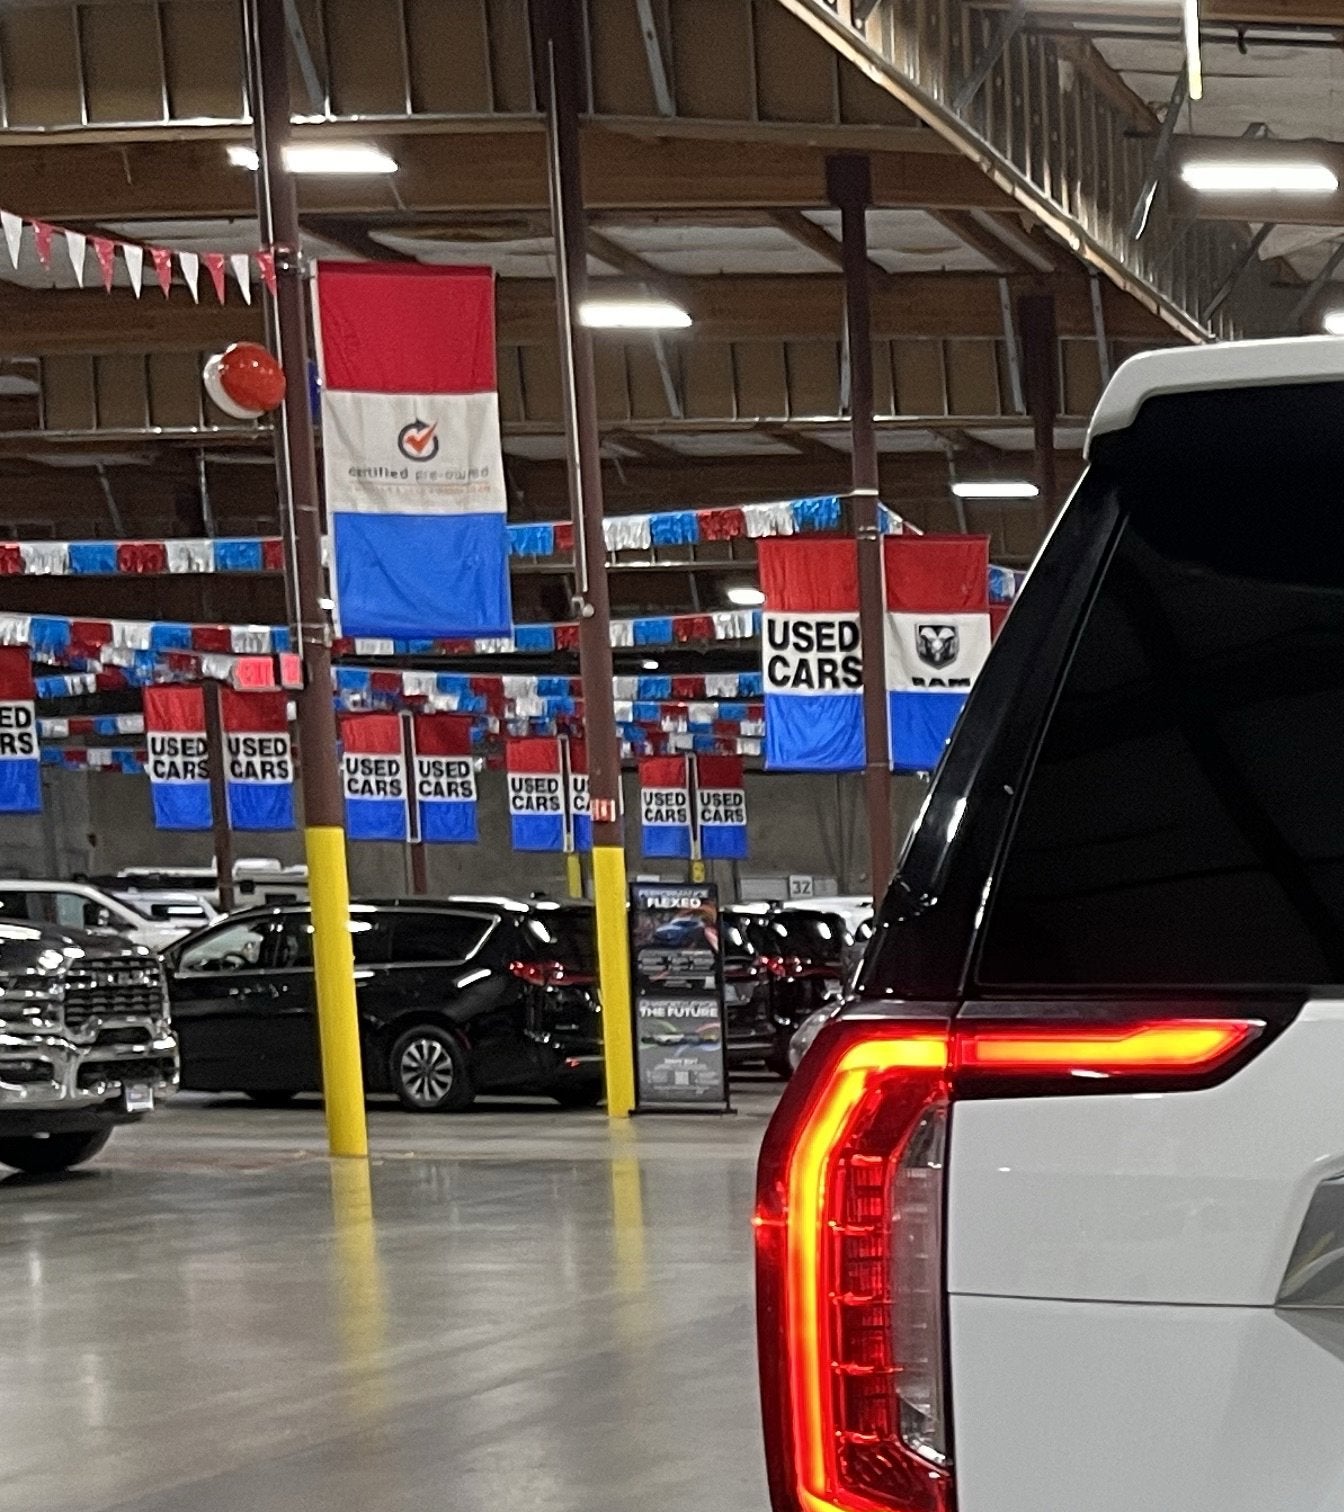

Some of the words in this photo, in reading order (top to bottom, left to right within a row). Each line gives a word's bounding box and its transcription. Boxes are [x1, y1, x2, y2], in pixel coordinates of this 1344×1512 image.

[767, 618, 860, 653] USED
[767, 655, 864, 689] CARS
[0, 706, 32, 728] ED
[0, 732, 34, 755] RS
[151, 737, 208, 758] USED
[227, 737, 288, 758] USED
[153, 760, 210, 780] CARS
[230, 760, 289, 780] CARS
[346, 758, 400, 777] USED
[418, 760, 470, 778] USED
[347, 778, 402, 796] CARS
[419, 780, 473, 798] CARS
[511, 778, 559, 794] USED
[511, 795, 561, 811] CARS
[643, 791, 686, 807] USED
[701, 792, 743, 807] USED
[644, 808, 687, 823] CARS
[701, 808, 744, 823] CARS
[792, 881, 811, 895] 32
[640, 1007, 666, 1018] THE
[667, 1006, 719, 1018] FUTURE
